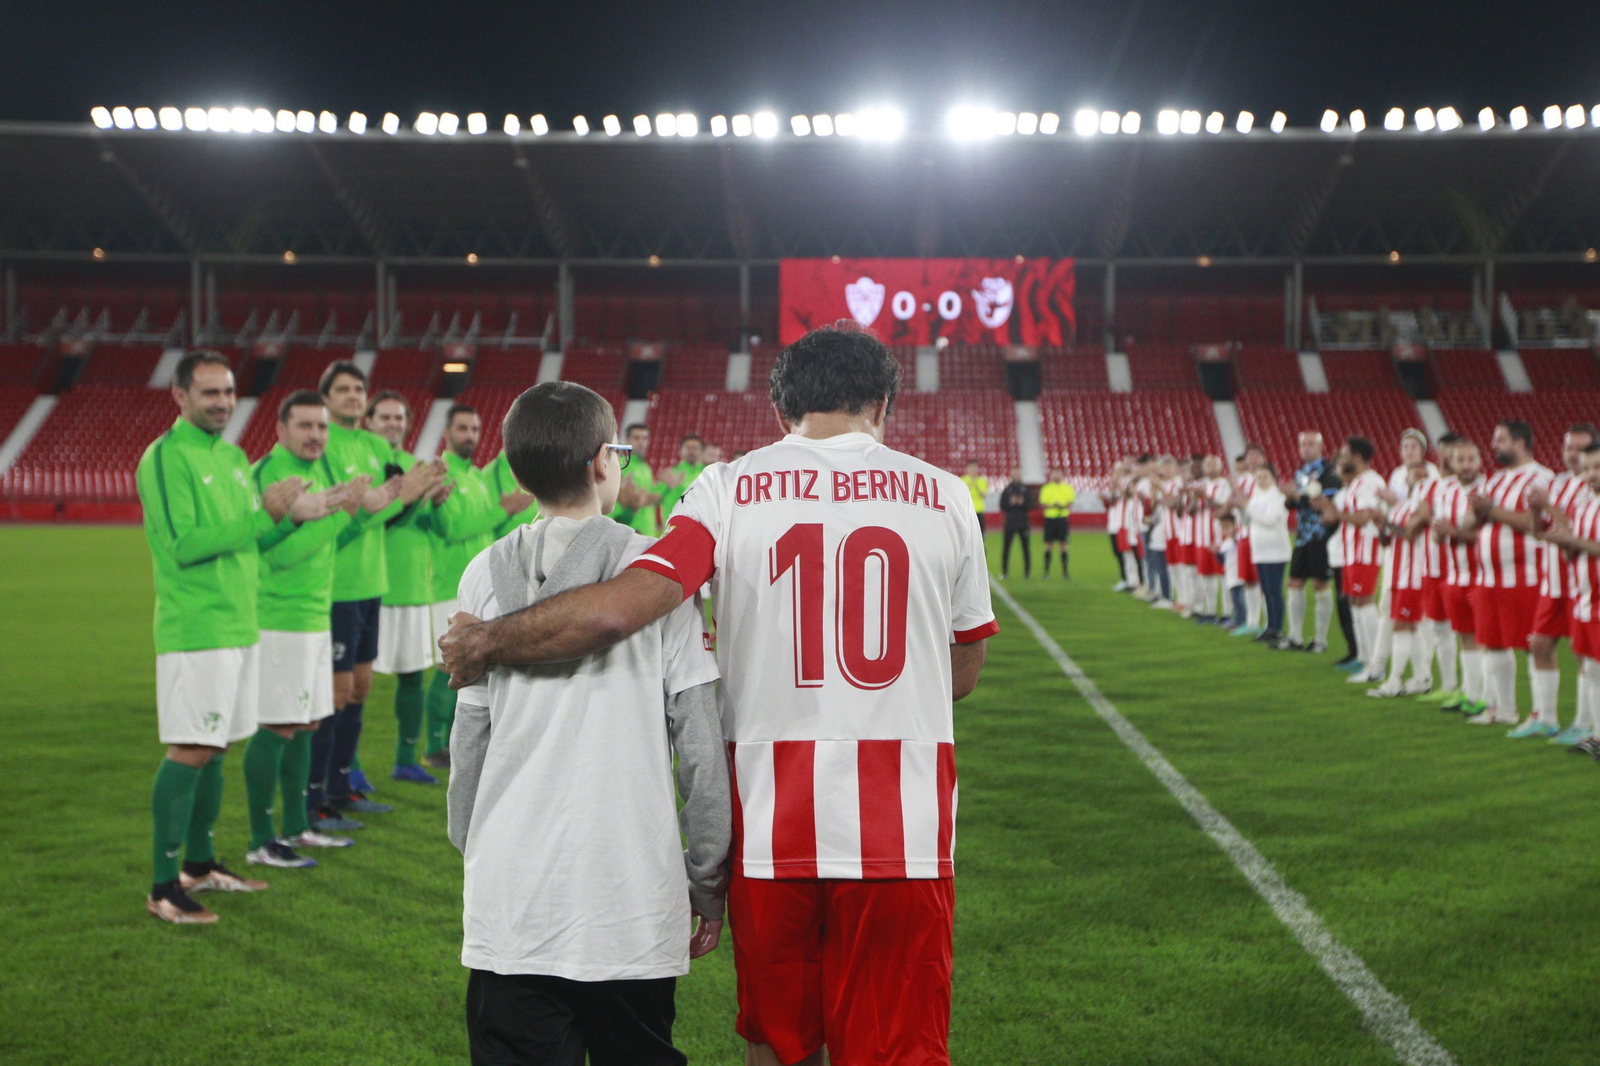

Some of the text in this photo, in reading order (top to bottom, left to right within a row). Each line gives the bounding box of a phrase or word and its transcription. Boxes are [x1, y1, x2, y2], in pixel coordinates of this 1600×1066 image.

[735, 470, 946, 513] ORTIZ BERNAL
[769, 523, 910, 690] 10
